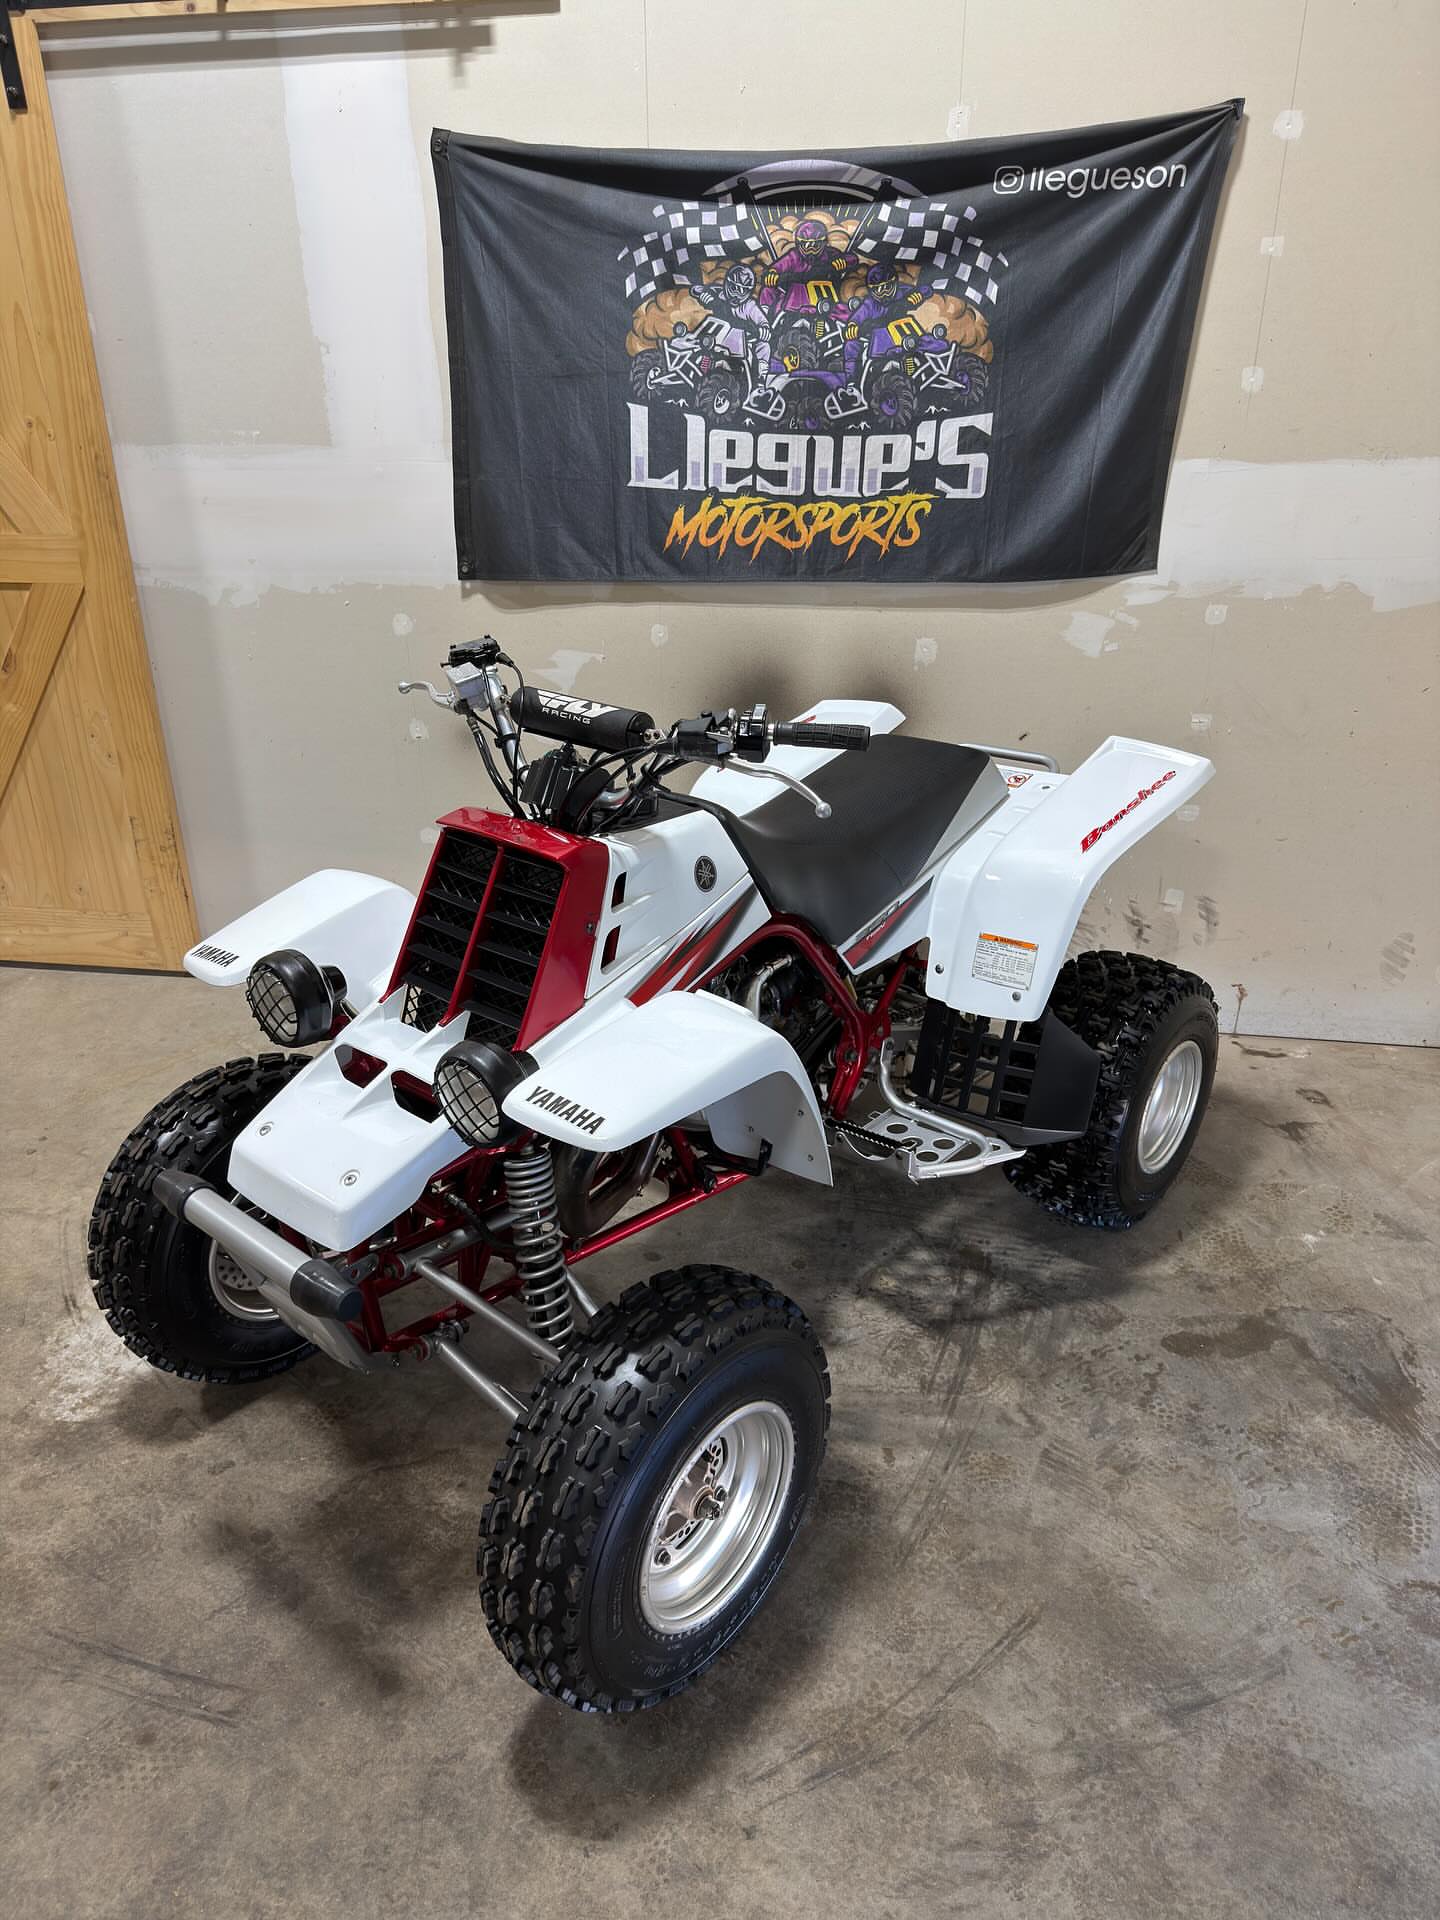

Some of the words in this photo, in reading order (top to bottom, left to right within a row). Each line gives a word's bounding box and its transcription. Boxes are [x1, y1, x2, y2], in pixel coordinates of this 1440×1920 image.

[1029, 163, 1187, 199] llegueson
[662, 489, 941, 565] MOTORSPORTS
[537, 689, 621, 719] FLY
[541, 706, 591, 725] RACING
[1080, 770, 1177, 854] Banshee
[191, 944, 240, 968] YAMAHA
[525, 1085, 606, 1135] YAMAHA
